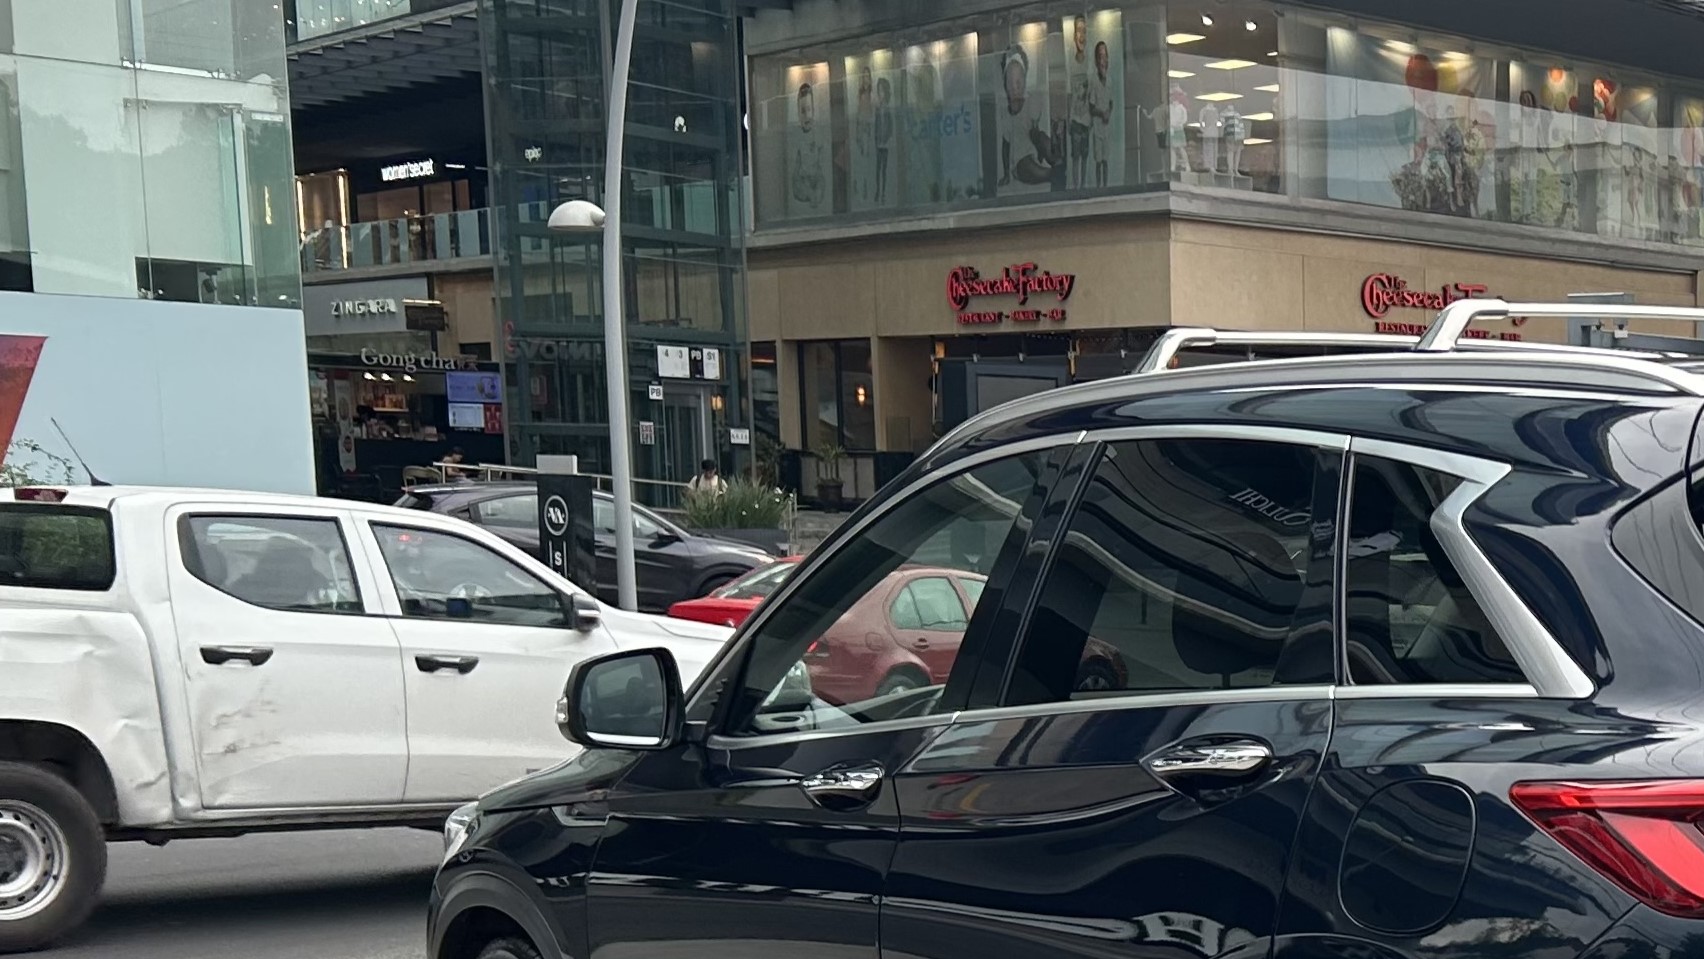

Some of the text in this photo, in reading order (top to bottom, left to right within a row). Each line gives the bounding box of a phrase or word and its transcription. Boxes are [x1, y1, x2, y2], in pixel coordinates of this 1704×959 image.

[331, 299, 397, 316] ZINGARA
[361, 348, 417, 372] Gong
[421, 351, 456, 370] cha
[650, 387, 662, 397] PB
